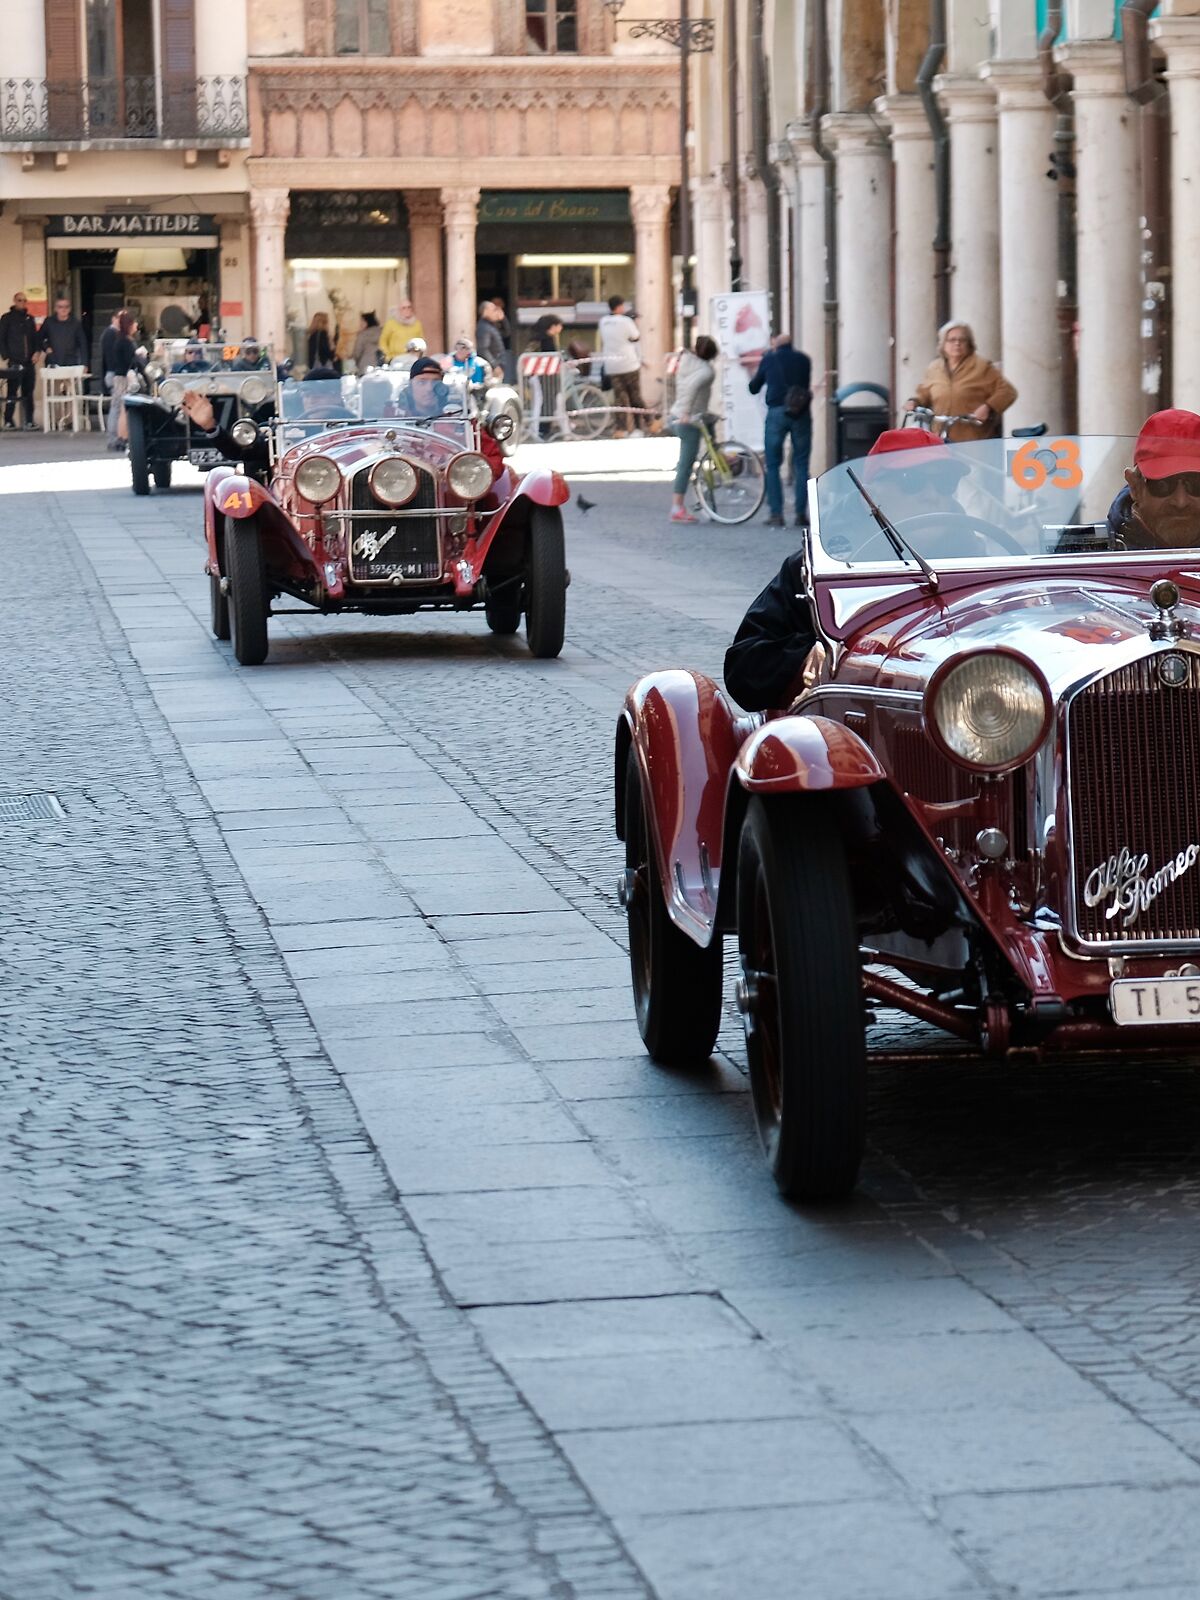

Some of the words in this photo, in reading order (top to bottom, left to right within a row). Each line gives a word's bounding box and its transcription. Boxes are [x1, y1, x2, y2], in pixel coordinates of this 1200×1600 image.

[523, 200, 545, 216] del
[63, 215, 106, 232] BAR
[106, 214, 201, 232] MATILDE
[224, 258, 238, 267] 25
[222, 345, 240, 360] 37
[1011, 438, 1084, 491] 63
[223, 491, 254, 510] 41
[1083, 846, 1150, 920] Alfa
[1117, 843, 1200, 928] Romeo
[1130, 987, 1161, 1017] TI
